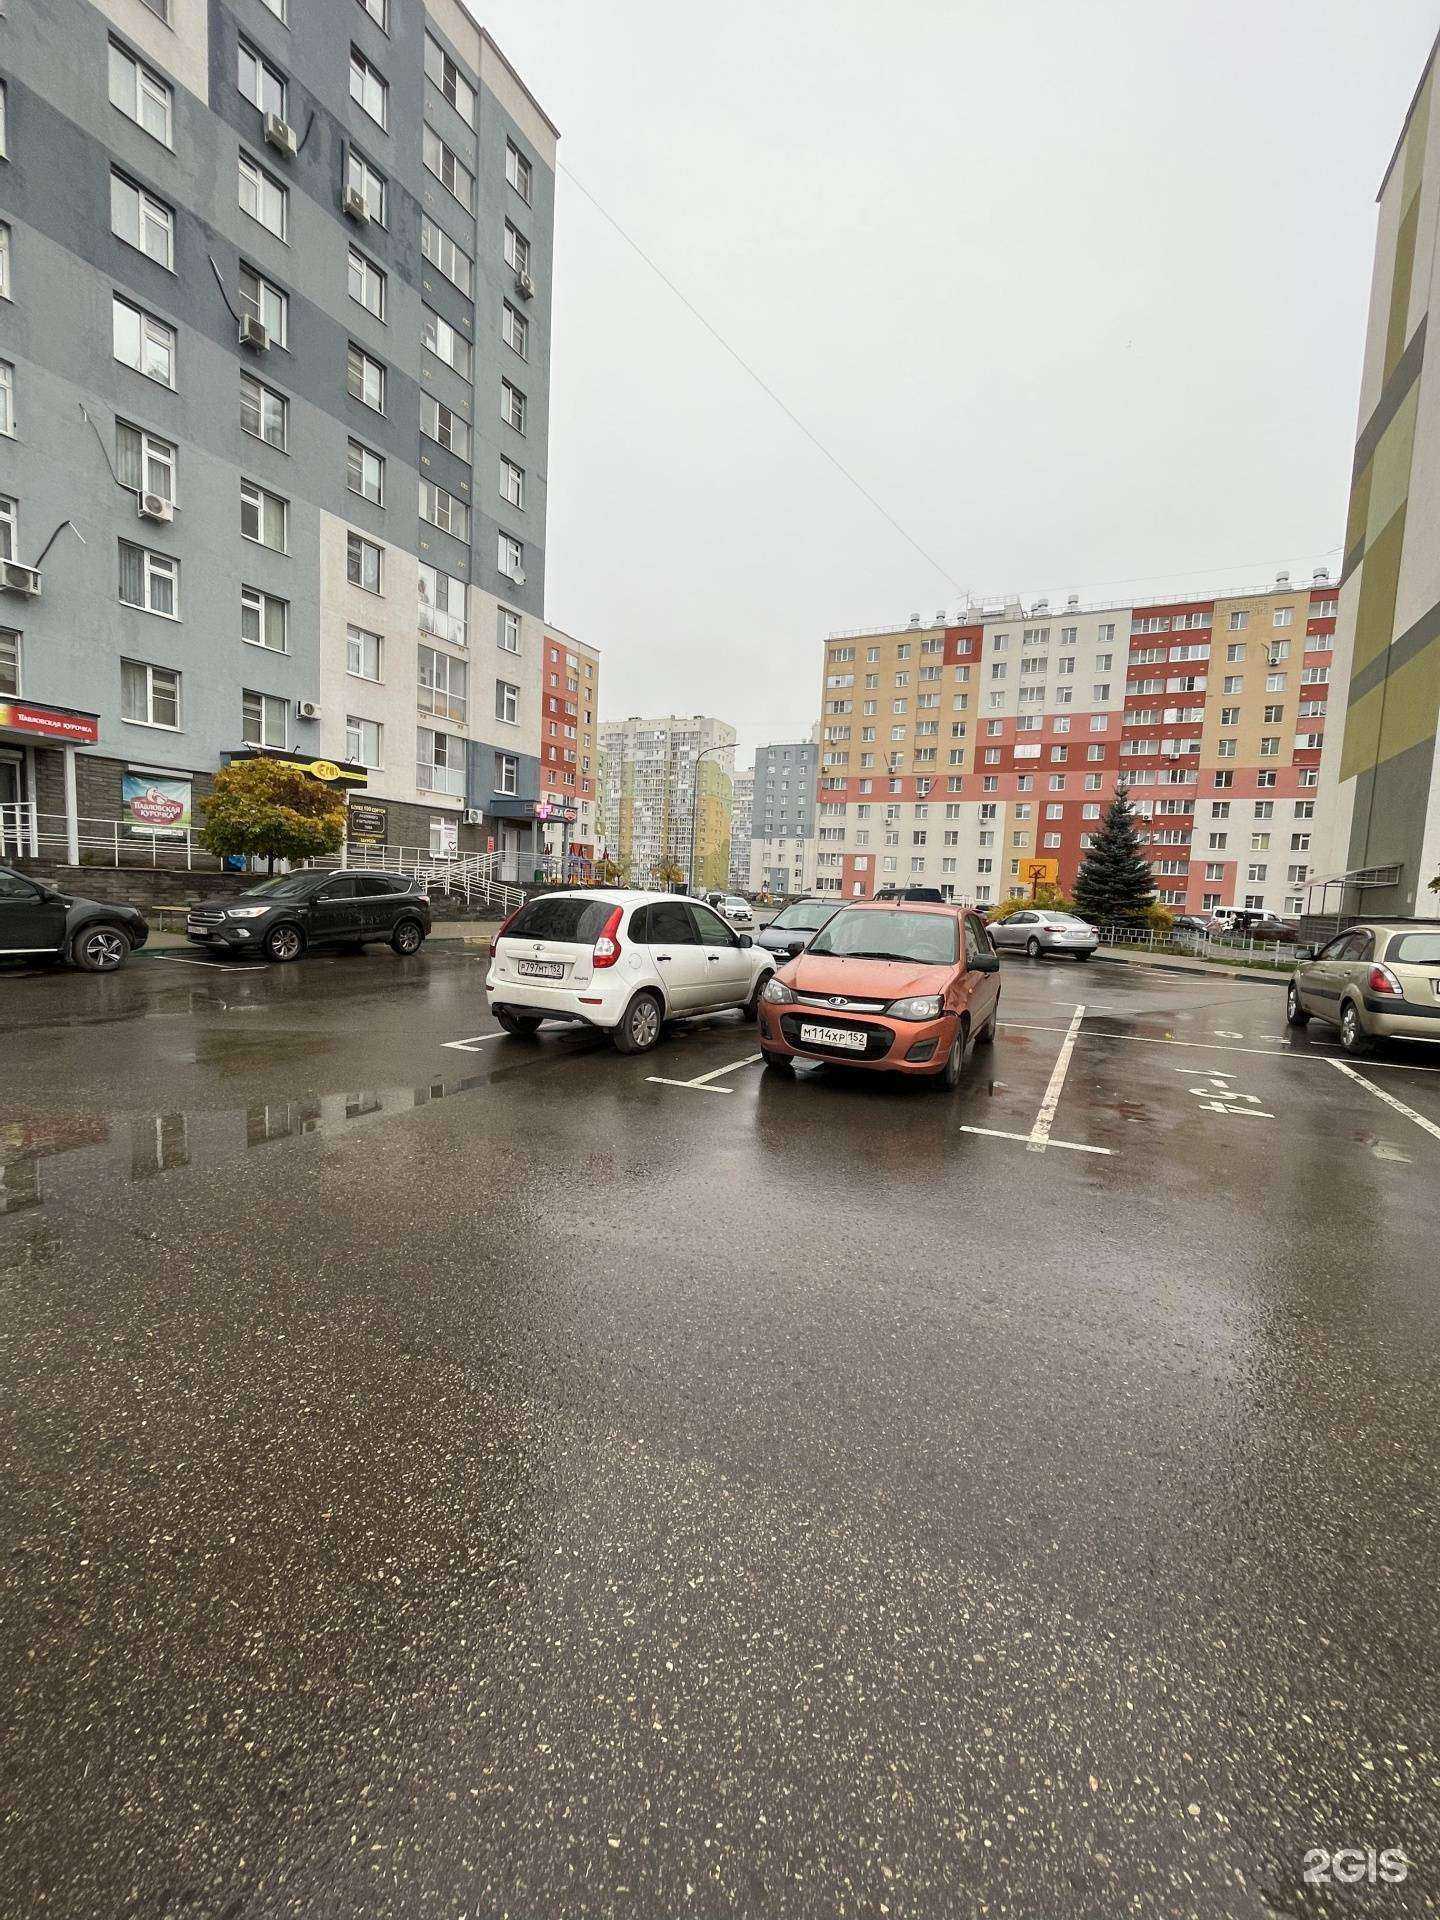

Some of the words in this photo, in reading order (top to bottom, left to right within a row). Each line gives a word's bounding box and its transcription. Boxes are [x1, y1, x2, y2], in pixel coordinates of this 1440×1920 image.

[62, 722, 93, 733] КУРОЧКА
[133, 801, 181, 815] ПАВЛОВСКАЯ
[140, 809, 175, 819] КУРОЧКА
[803, 1028, 845, 1042] М114ХР
[848, 1033, 865, 1043] 152
